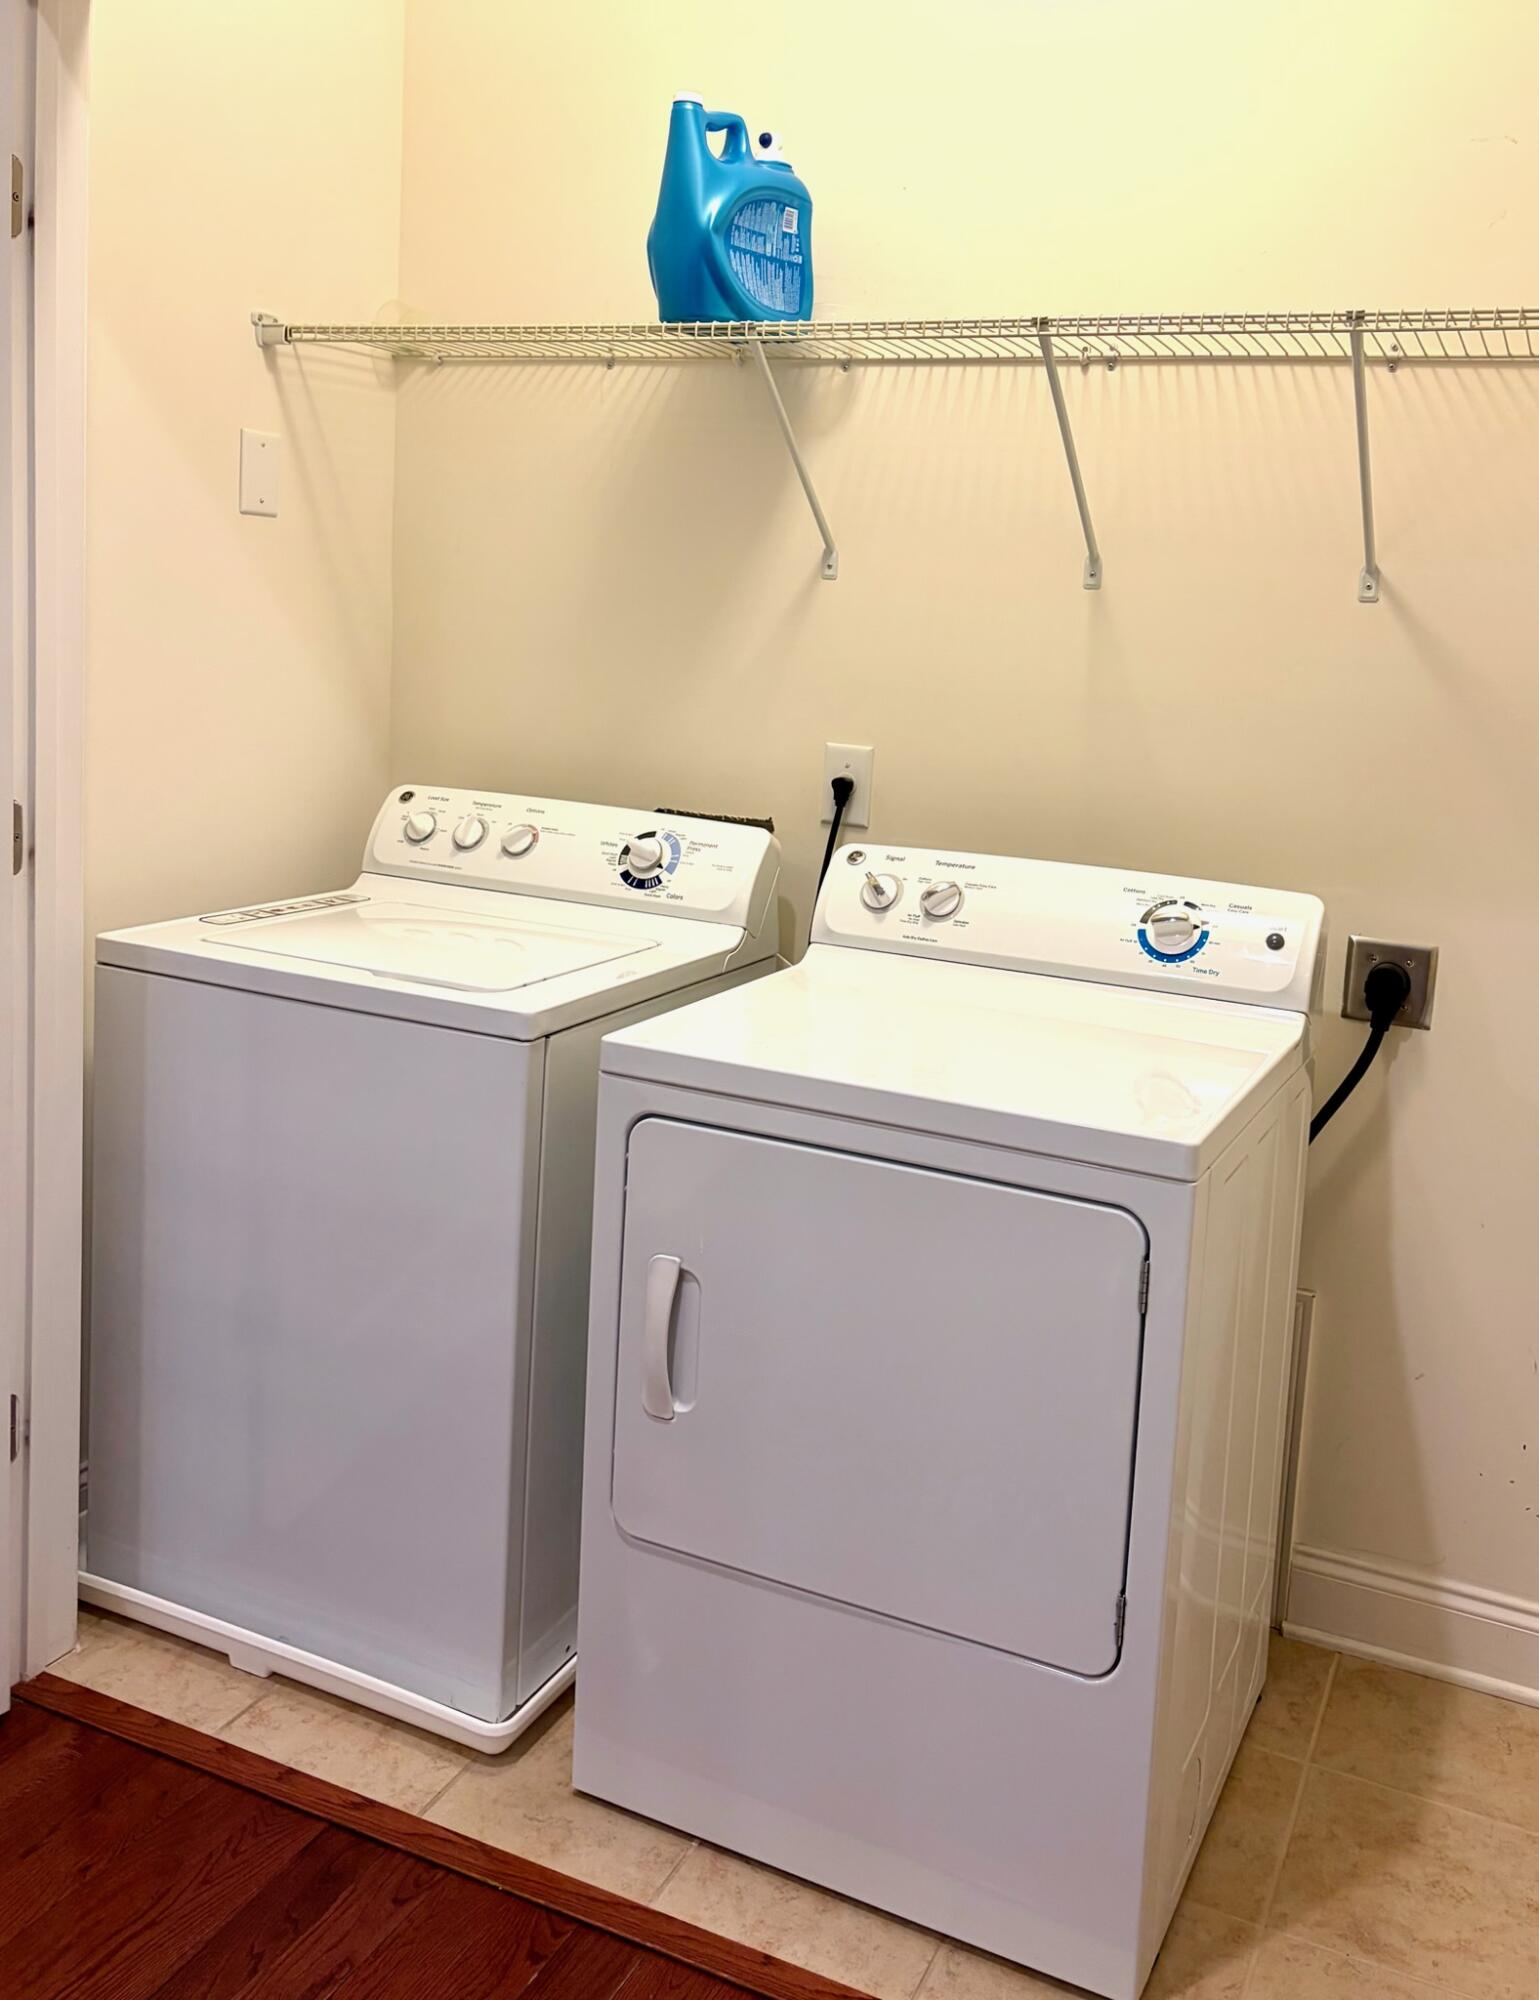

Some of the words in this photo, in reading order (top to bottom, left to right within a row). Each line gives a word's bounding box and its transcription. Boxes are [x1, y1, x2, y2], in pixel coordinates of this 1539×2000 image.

[688, 840, 719, 849] Permanent
[885, 854, 906, 862] Signal
[935, 860, 976, 870] Temperature
[666, 892, 684, 901] Colors
[1228, 902, 1252, 911] Casuals
[1192, 967, 1207, 975] Time
[1208, 968, 1220, 977] Dry
